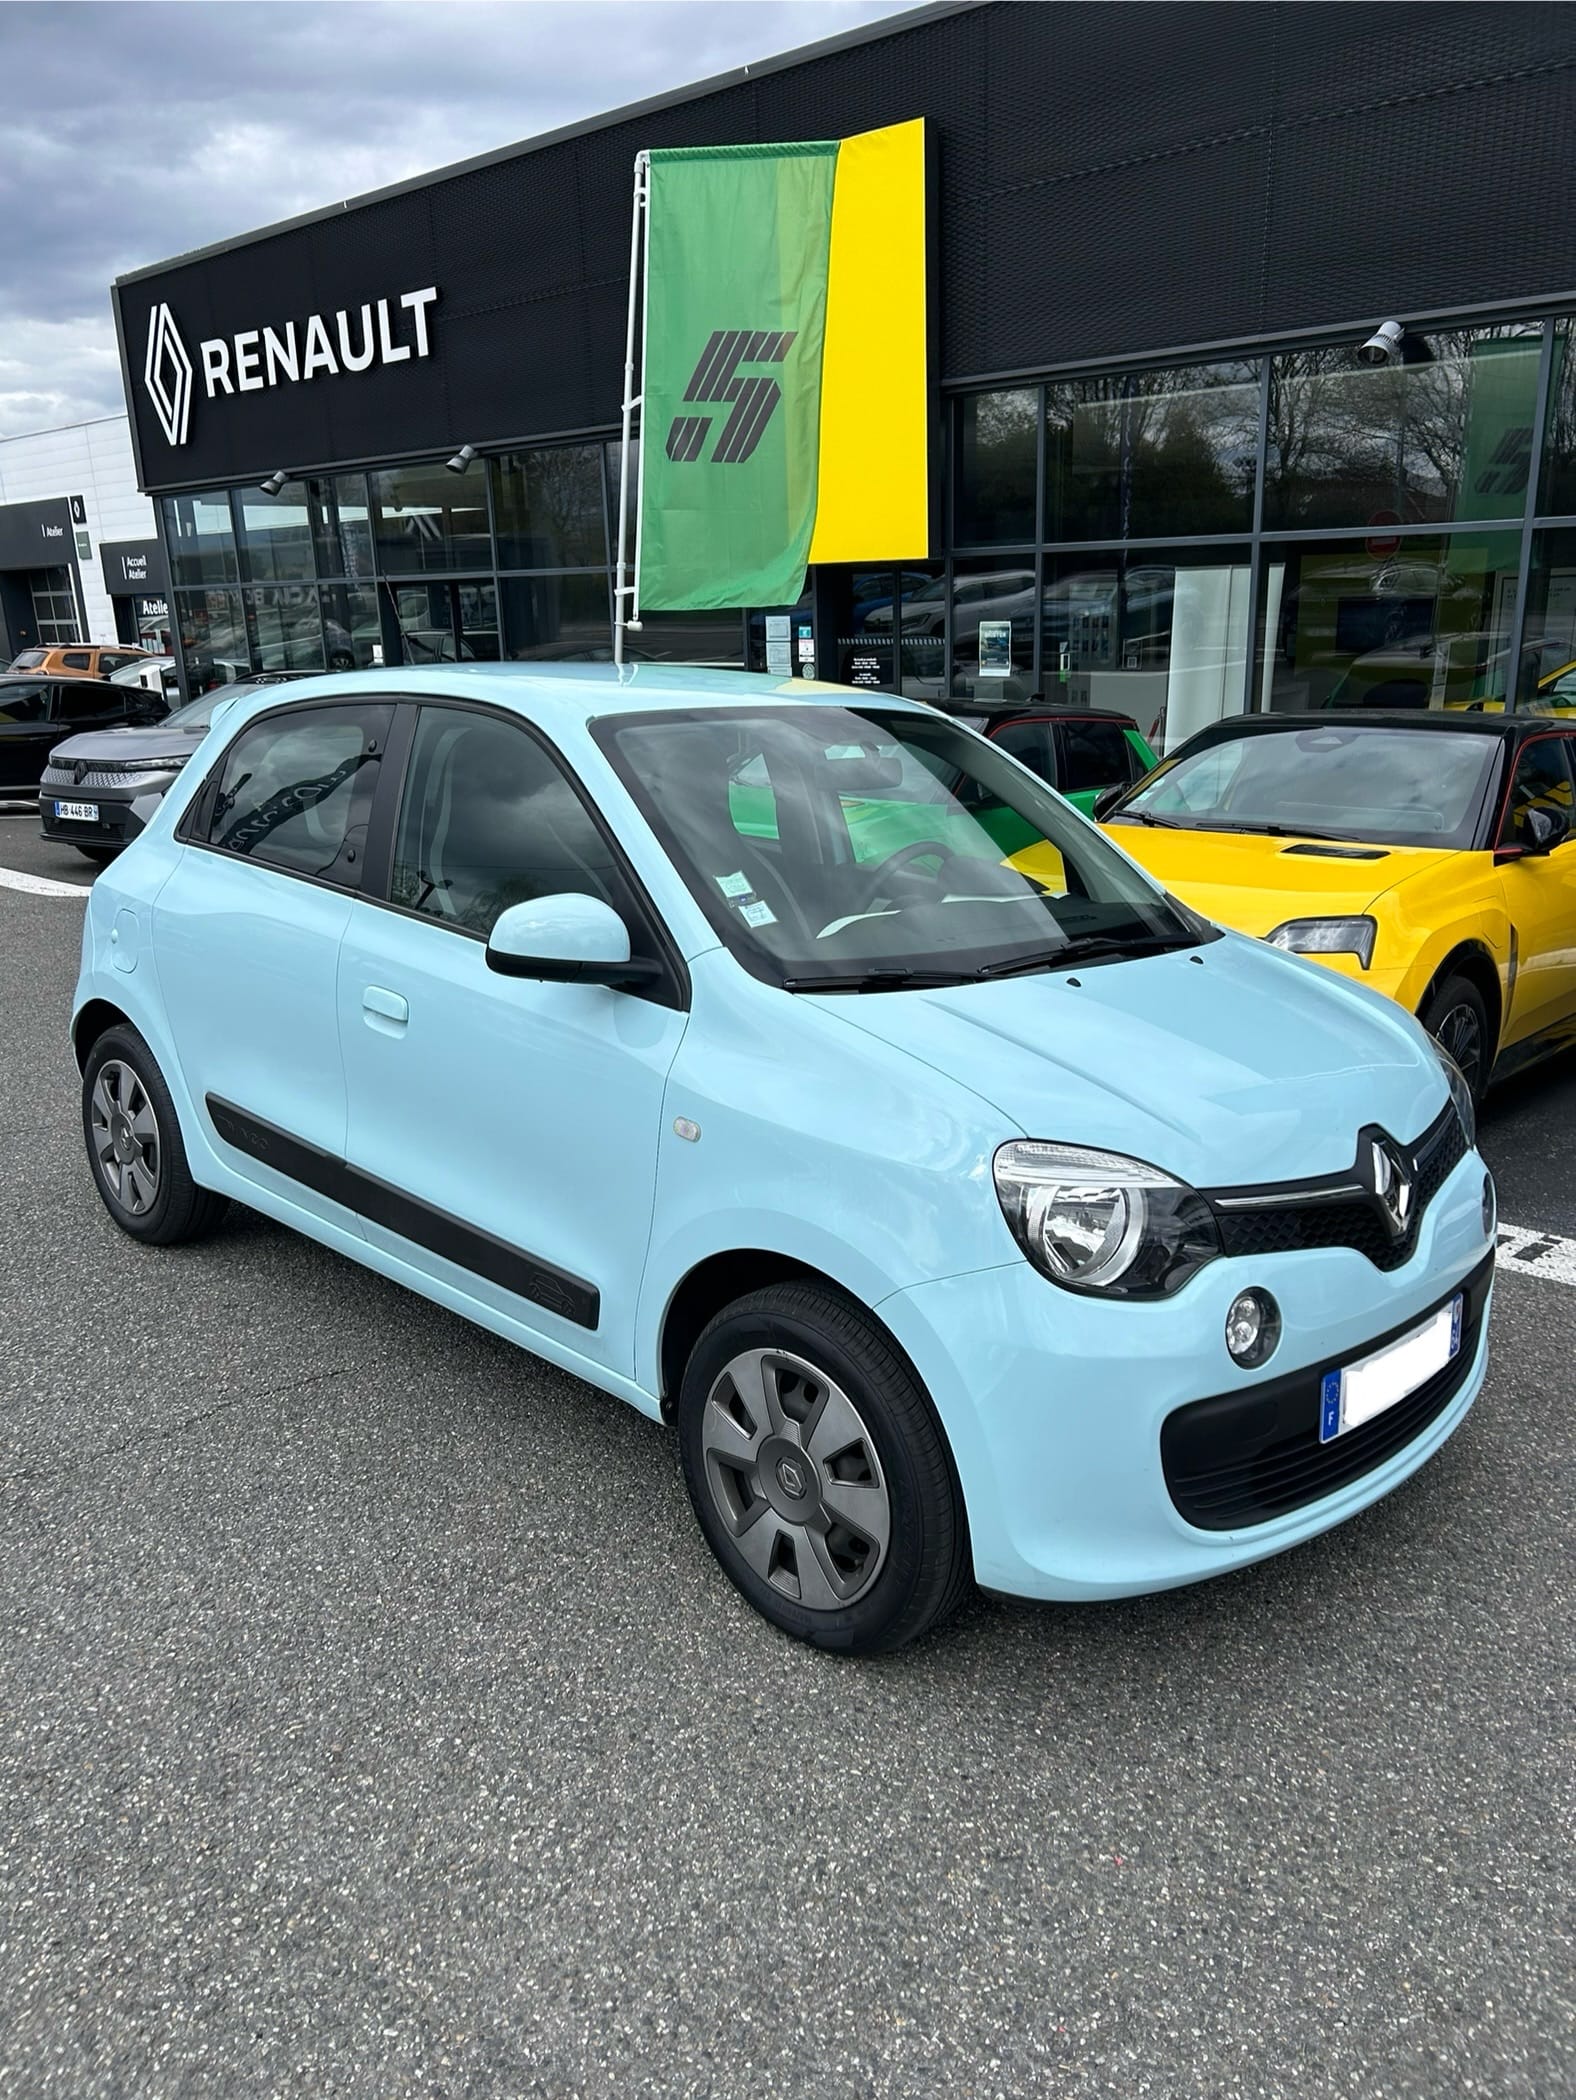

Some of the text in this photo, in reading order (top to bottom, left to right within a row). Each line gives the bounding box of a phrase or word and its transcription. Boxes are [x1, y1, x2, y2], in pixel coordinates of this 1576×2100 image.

[200, 286, 437, 398] RENAULT
[665, 330, 799, 463] 5
[46, 525, 63, 537] Atelier
[127, 555, 147, 567] Accueil
[128, 568, 147, 579] Atelier
[143, 600, 169, 616] Atelie
[1327, 1411, 1334, 1426] F
